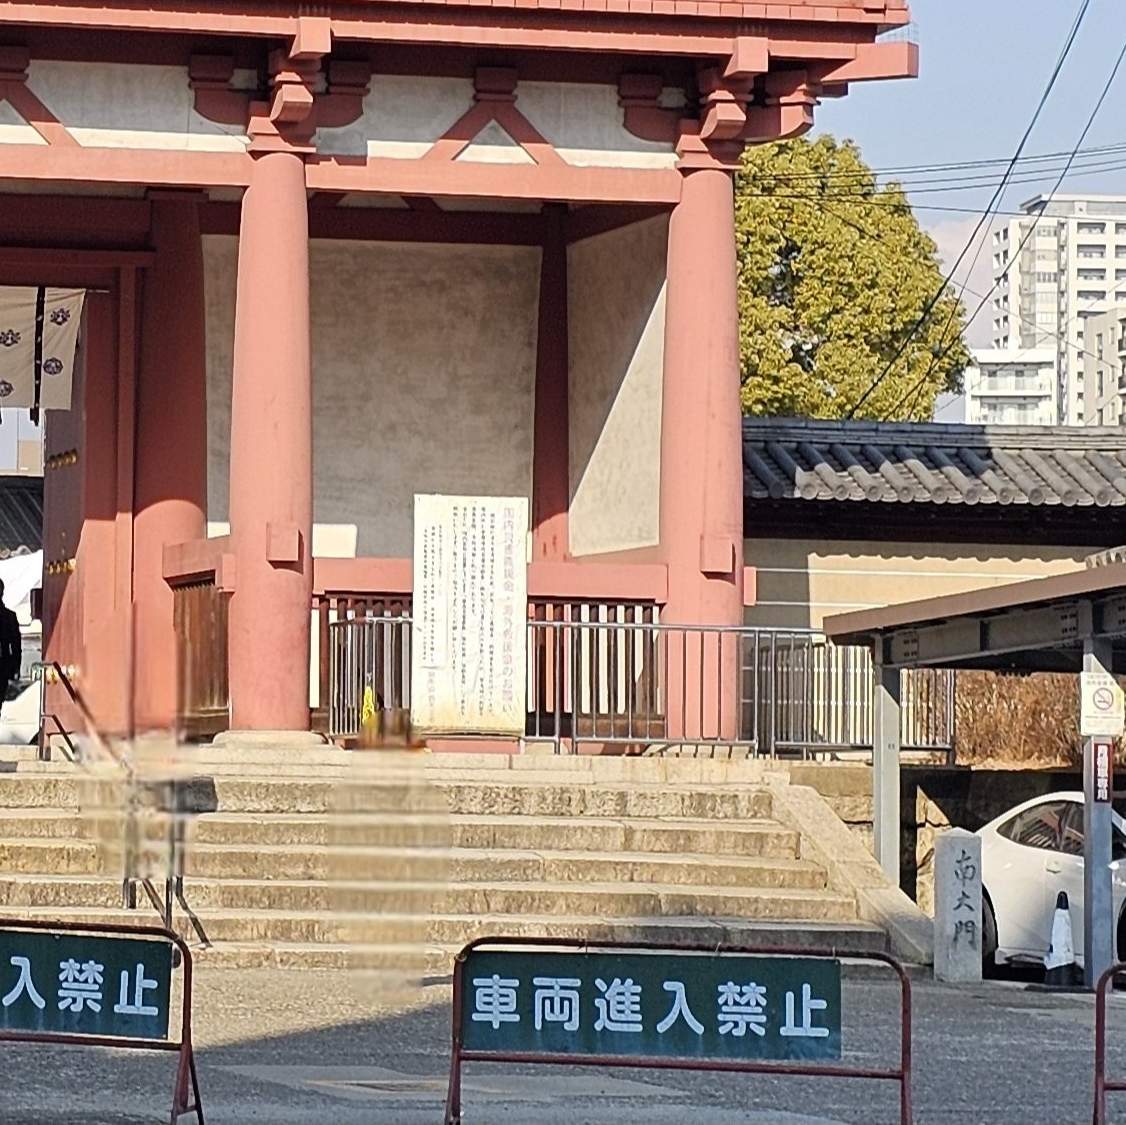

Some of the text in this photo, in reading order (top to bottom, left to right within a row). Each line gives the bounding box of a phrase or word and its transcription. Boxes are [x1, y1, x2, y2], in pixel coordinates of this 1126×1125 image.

[953, 849, 978, 951] 南大門
[471, 974, 830, 1038] 車両進入禁止
